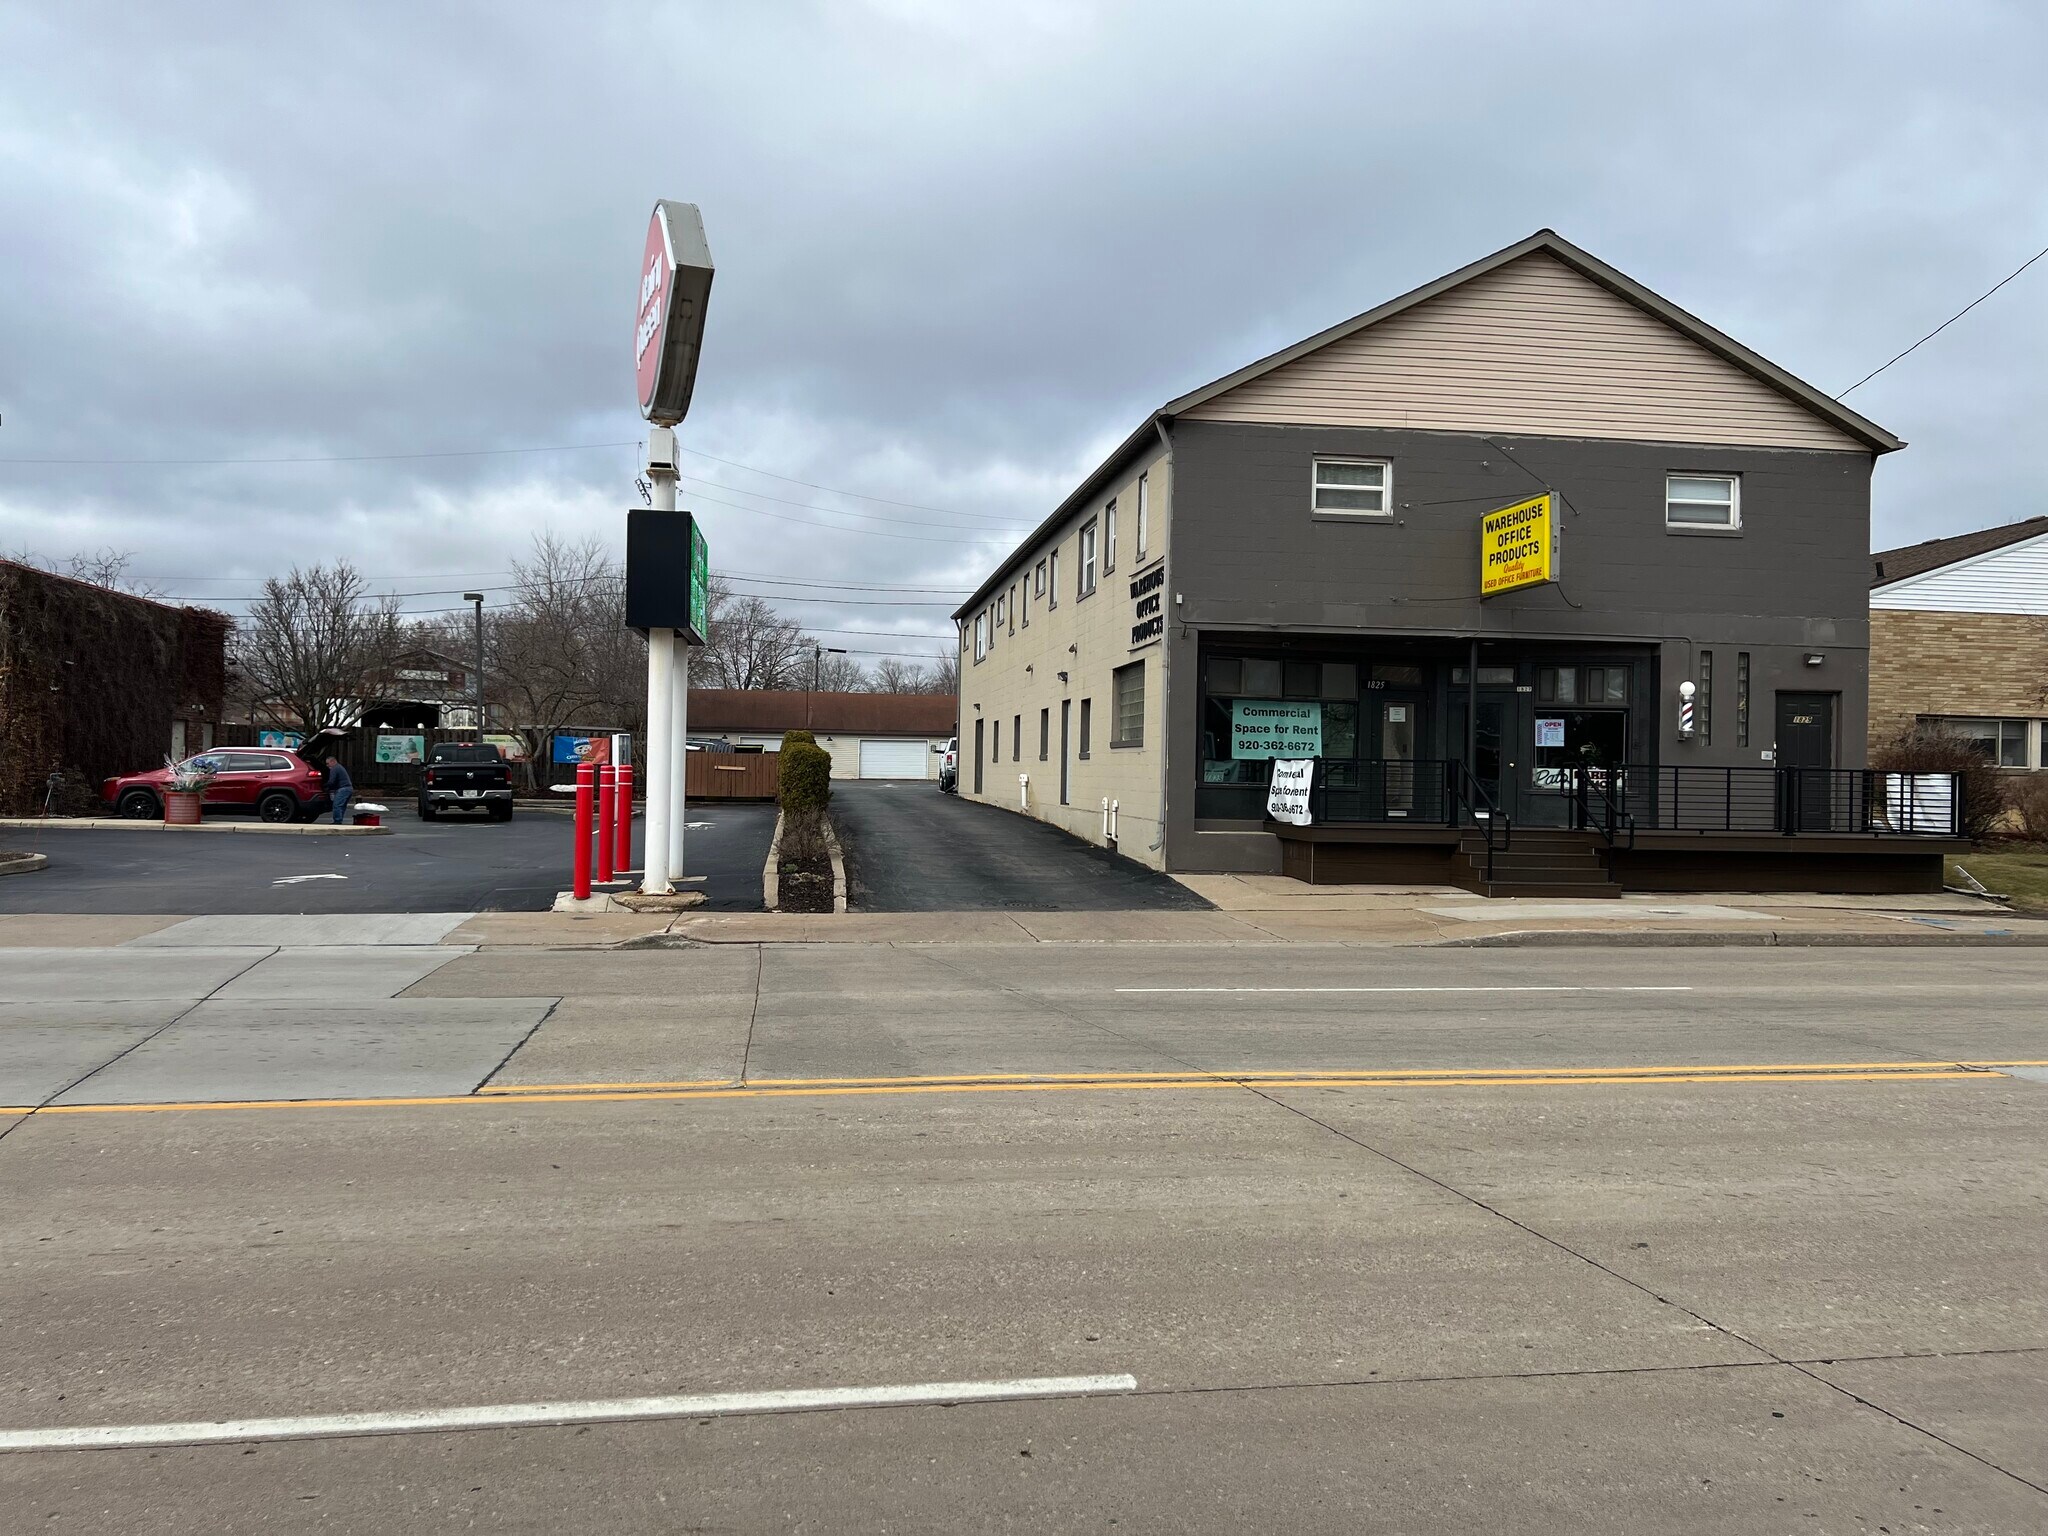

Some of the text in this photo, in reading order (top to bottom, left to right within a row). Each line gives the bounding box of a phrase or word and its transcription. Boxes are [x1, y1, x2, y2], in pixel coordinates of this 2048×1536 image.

[1485, 503, 1543, 534] WAREHOUSE
[1497, 525, 1531, 547] OFFICE
[1489, 540, 1540, 566] PRODUCTS
[1503, 560, 1525, 574] Quality
[1484, 567, 1542, 589] USED OFFICE FURNITURE
[1367, 681, 1385, 689] 1825
[1243, 707, 1310, 718] Commercial
[1234, 724, 1318, 735] Space for Rent
[1238, 740, 1315, 751] 920-362-6672
